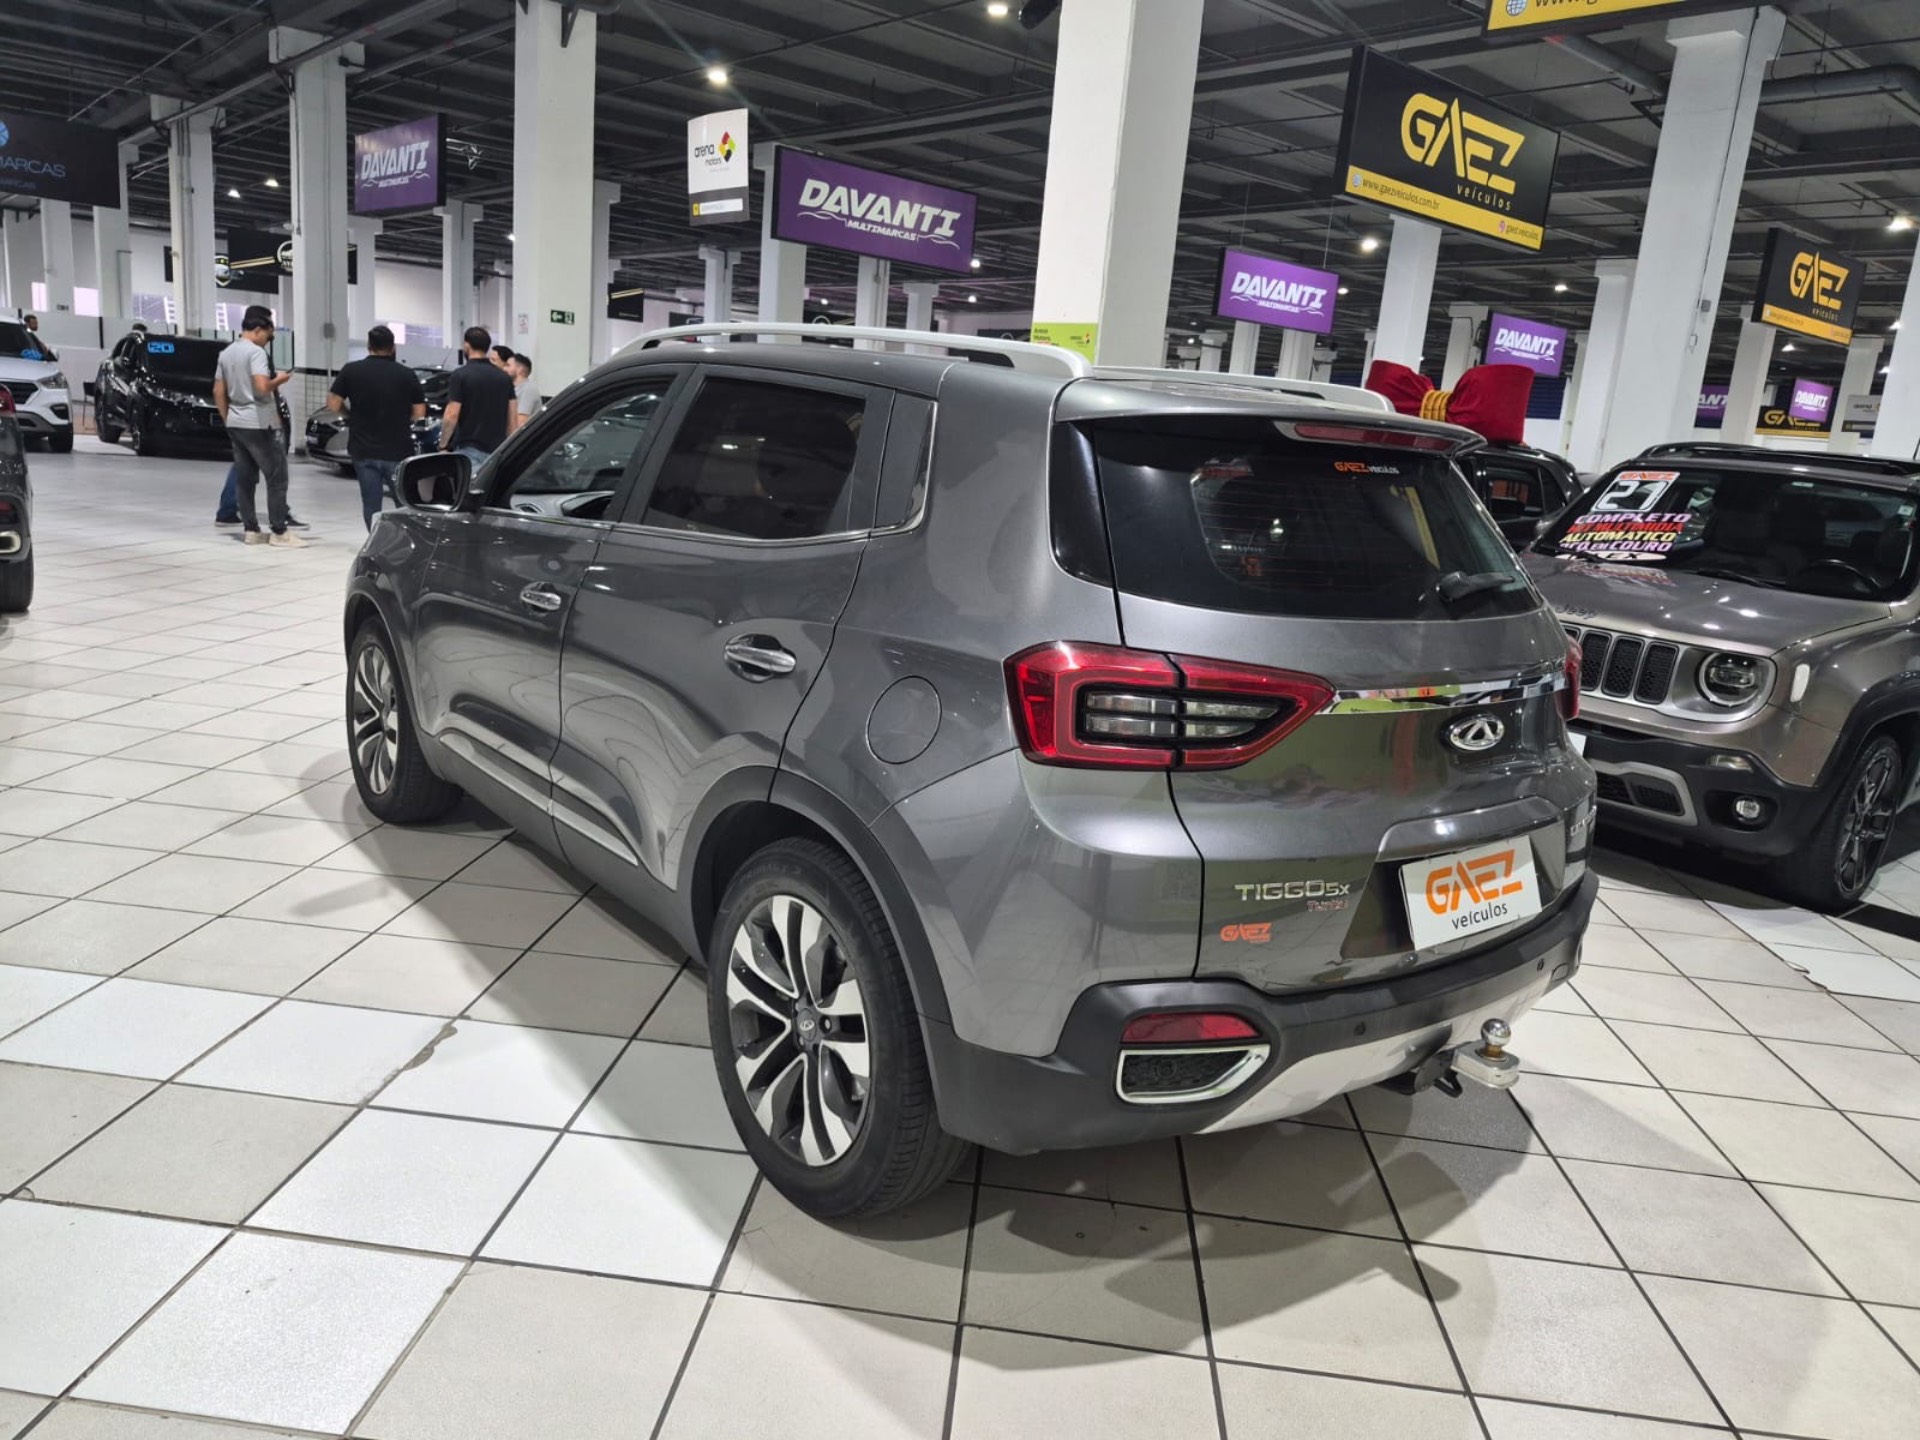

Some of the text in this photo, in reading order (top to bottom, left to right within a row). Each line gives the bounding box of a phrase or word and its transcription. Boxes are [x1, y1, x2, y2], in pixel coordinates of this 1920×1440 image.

[1401, 92, 1526, 195] GAEZ
[361, 141, 430, 180] DAVANTI
[799, 178, 961, 237] DAVANTI
[847, 219, 917, 241] MULTIMARCAS
[1230, 271, 1327, 309] DAVANTI
[1789, 251, 1849, 310] GAEZ
[1494, 327, 1559, 356] DAVANTI
[1574, 513, 1692, 525] COMPLETO
[1559, 530, 1677, 543] AUTOMATICO
[1609, 541, 1673, 552] COURO
[1426, 849, 1524, 916] GAEZ
[1220, 923, 1272, 941] GAEZ
